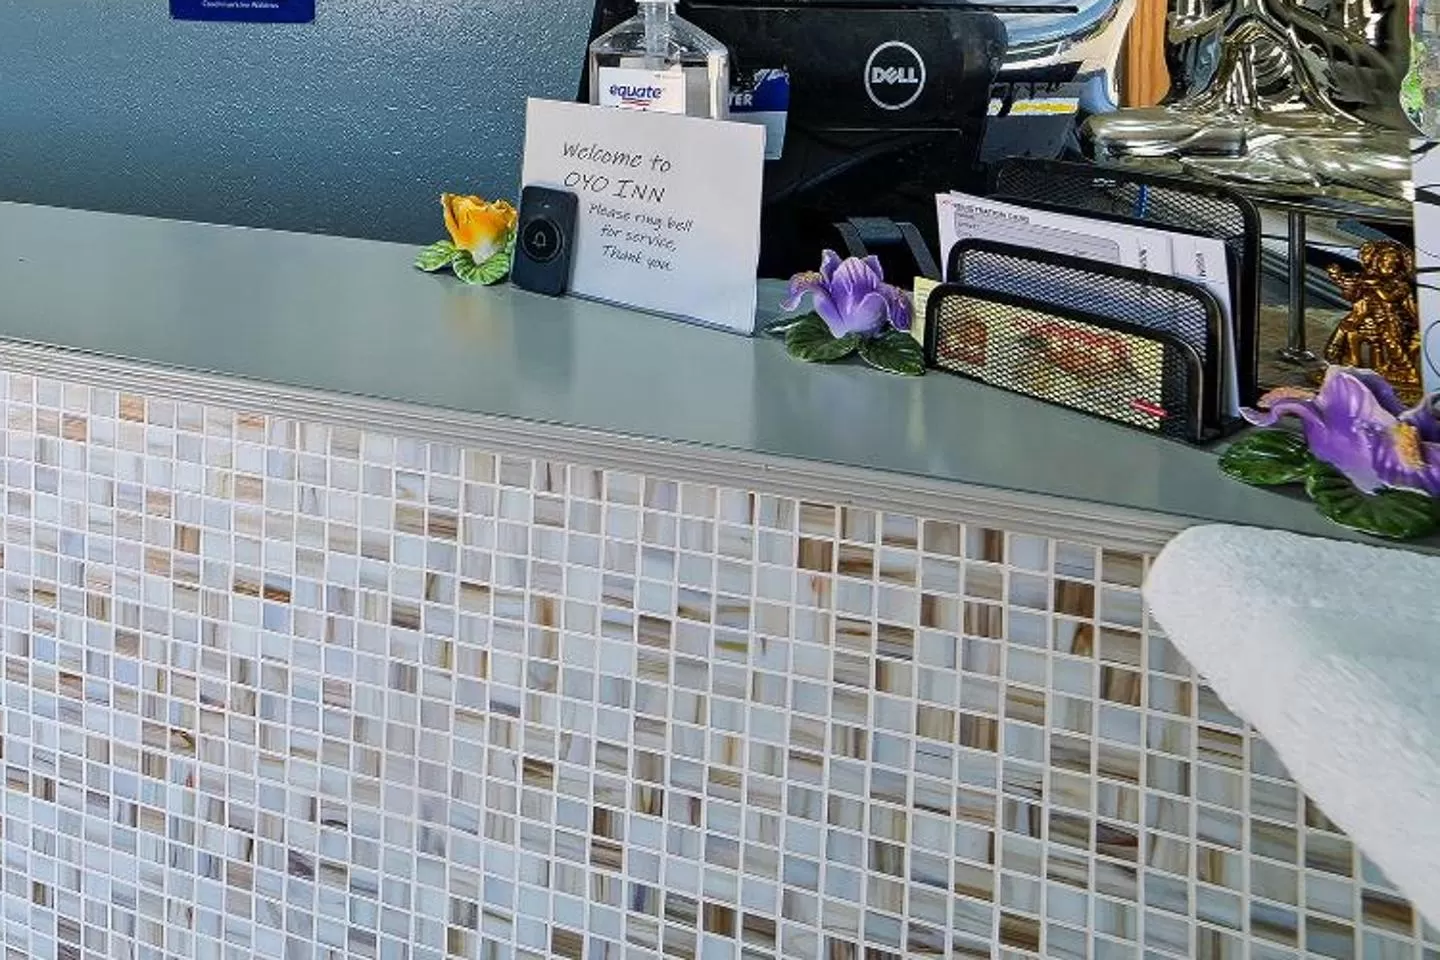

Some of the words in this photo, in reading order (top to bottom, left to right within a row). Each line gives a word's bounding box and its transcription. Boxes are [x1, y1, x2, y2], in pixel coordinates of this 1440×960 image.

[871, 66, 919, 85] DELL
[609, 83, 662, 100] equate
[562, 141, 643, 168] Welcome
[650, 153, 672, 173] to
[564, 171, 610, 193] OYO
[612, 179, 666, 203] INN
[588, 202, 631, 222] Please
[634, 214, 663, 232] ring
[667, 217, 695, 233] bell
[600, 223, 623, 238] for
[602, 245, 642, 264] Thank
